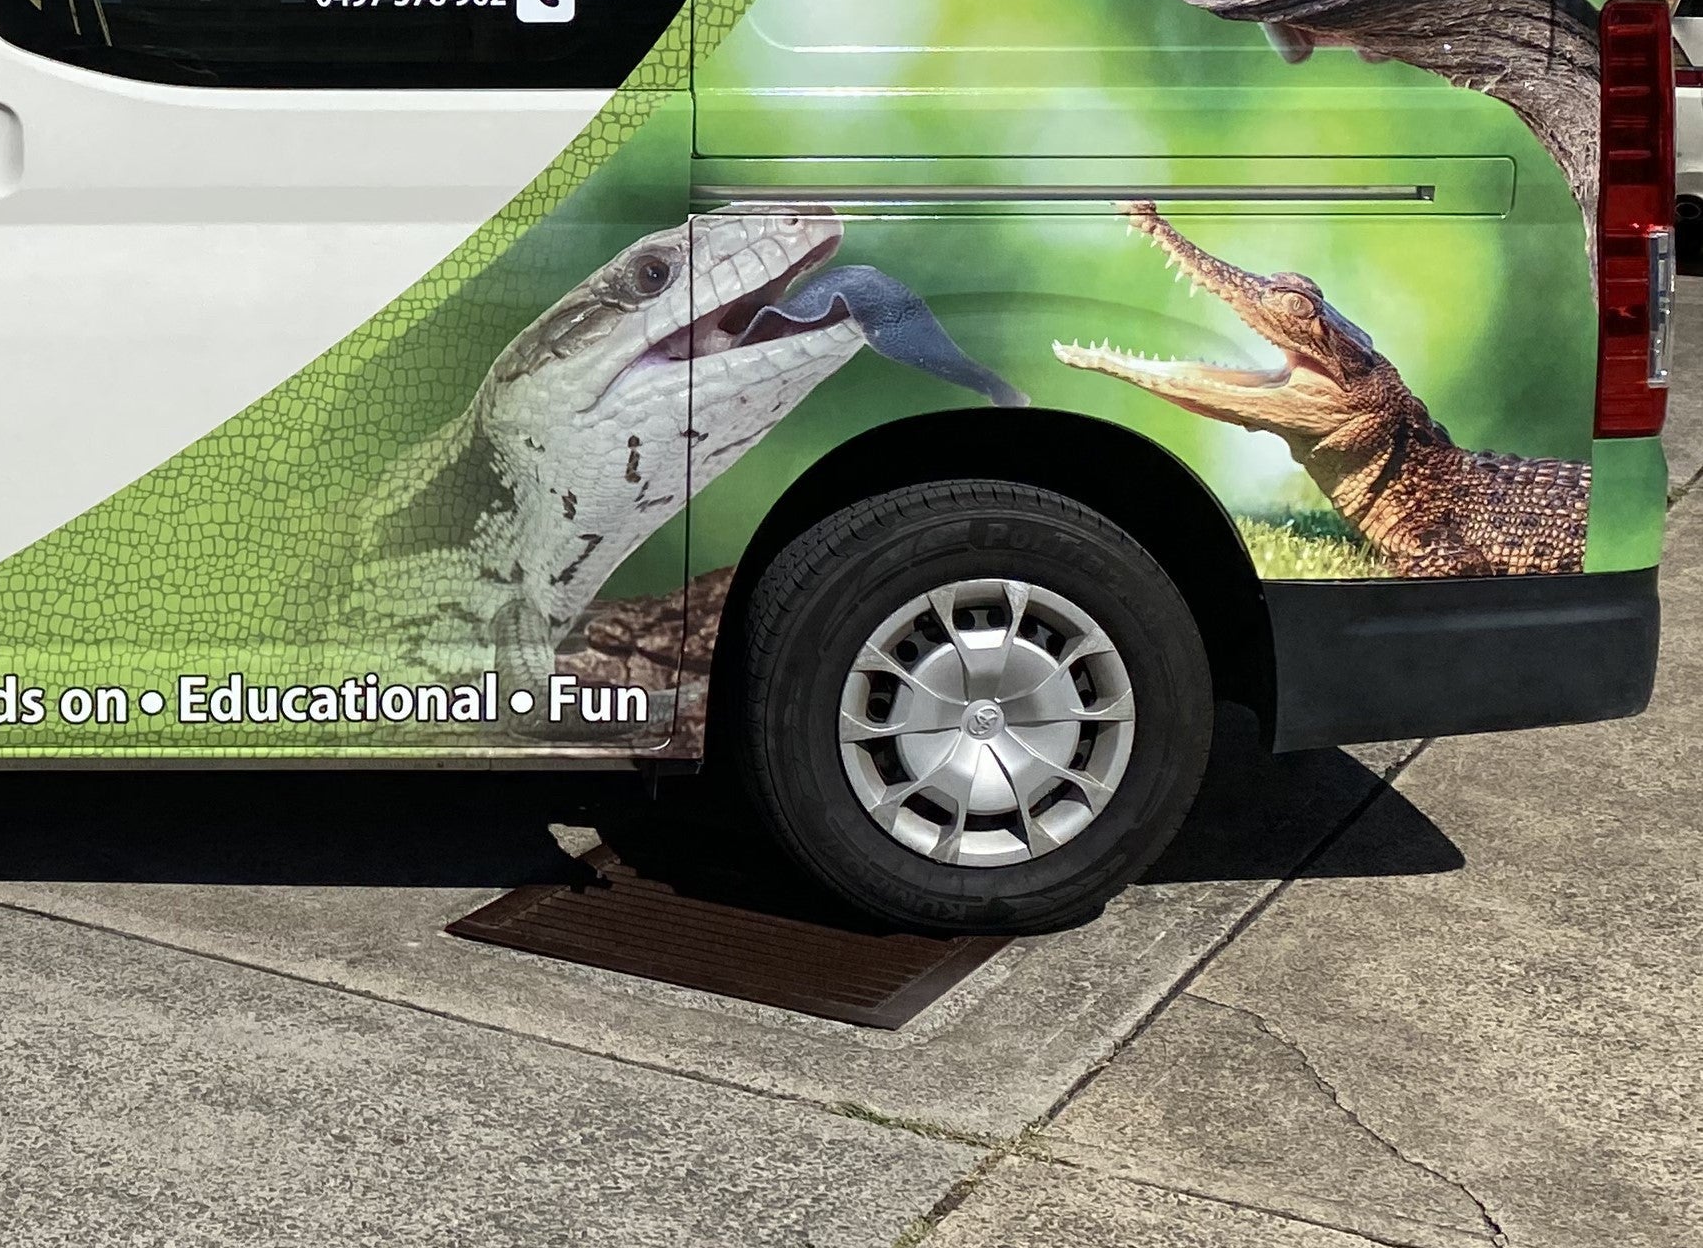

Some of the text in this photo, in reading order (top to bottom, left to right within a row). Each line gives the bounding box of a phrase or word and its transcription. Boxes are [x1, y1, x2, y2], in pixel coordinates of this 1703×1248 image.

[59, 686, 129, 723] on
[178, 673, 498, 723] Educational
[548, 676, 650, 723] Fun
